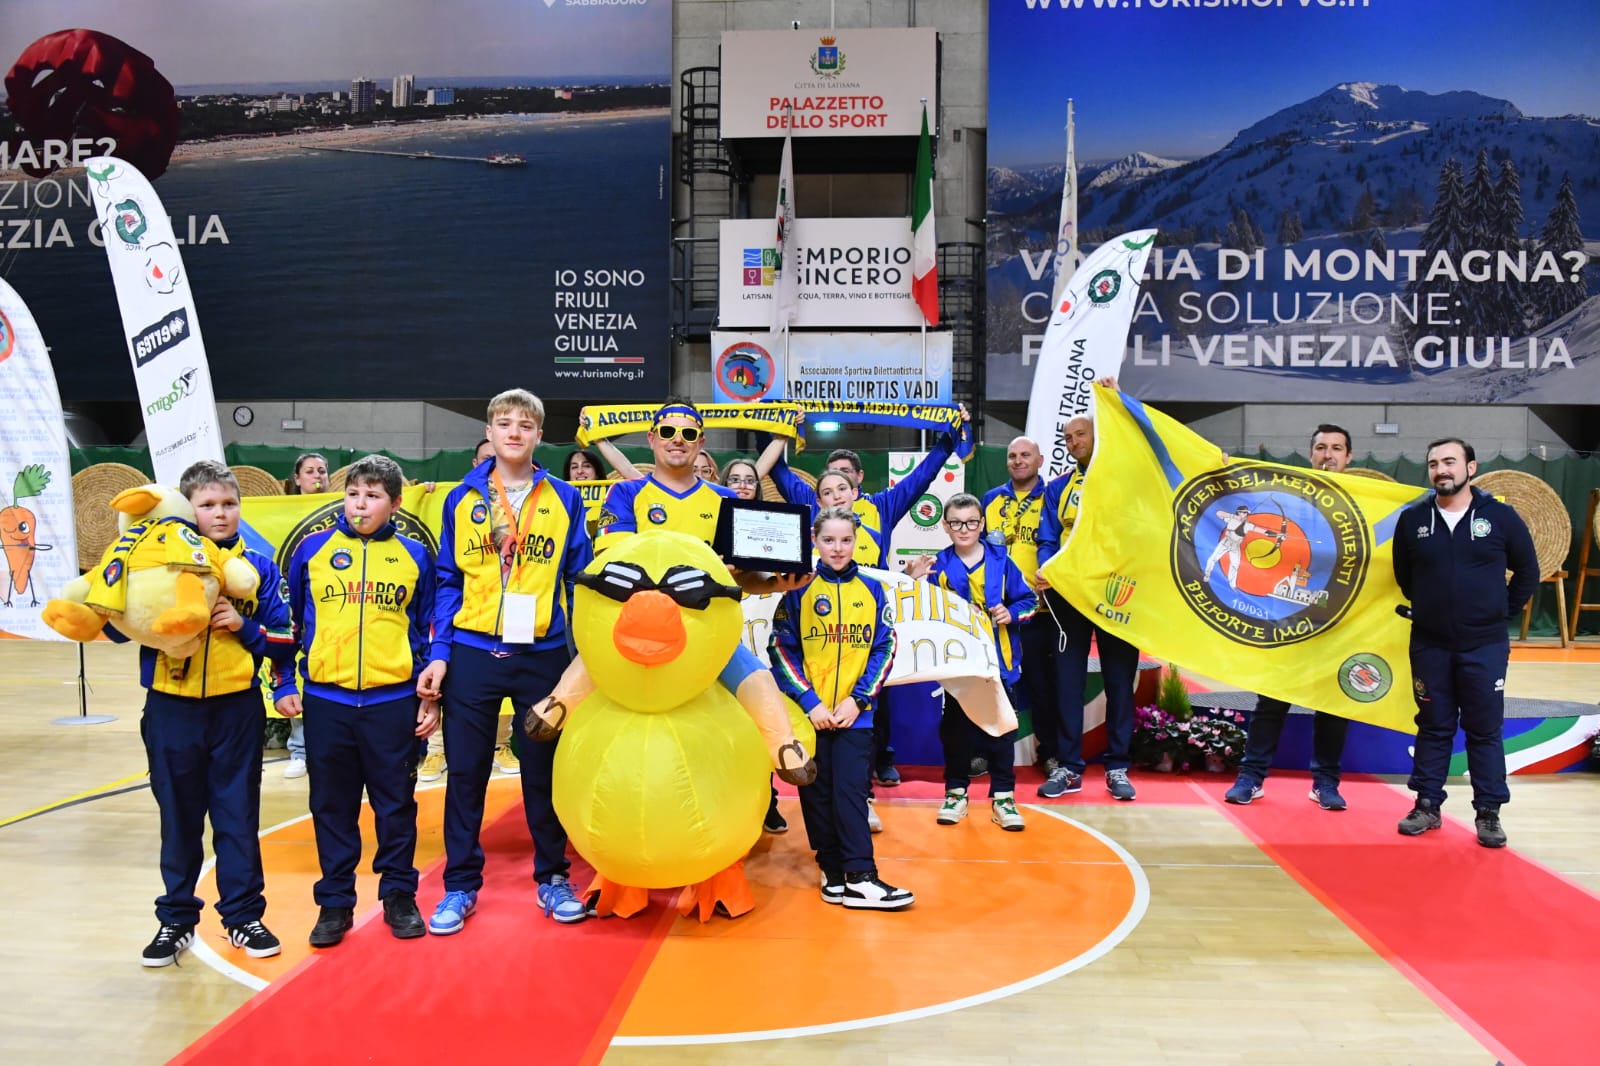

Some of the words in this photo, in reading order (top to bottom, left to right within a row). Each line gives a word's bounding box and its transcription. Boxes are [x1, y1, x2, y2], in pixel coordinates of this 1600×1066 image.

[769, 96, 884, 111] PALAZZETTO
[766, 114, 823, 129] DELLO
[829, 113, 888, 128] SPORT
[0, 137, 117, 170] ARE?
[0, 179, 94, 208] ZION
[0, 218, 74, 249] ZIA
[1217, 249, 1265, 281] DI
[1284, 248, 1587, 283] MONTAGNA?
[555, 270, 577, 287] IO
[583, 269, 645, 287] SONO
[555, 291, 609, 308] FRIULI
[798, 293, 821, 301] CQUA,
[823, 293, 847, 301] TERRA,
[1178, 291, 1462, 325] SOLUZIONE:
[554, 313, 638, 330] VENEZIA
[554, 335, 619, 352] GIULIA
[1187, 334, 1399, 368] VENEZIA
[1413, 335, 1576, 369] GIULIA
[554, 368, 645, 381] www.turismofvg.it
[800, 365, 843, 376] Associazione
[844, 365, 872, 377] Sportiva
[873, 365, 923, 376] Dilettantistica
[1058, 338, 1087, 418] ITALIANA
[787, 380, 841, 399] ARCIERI
[846, 380, 899, 399] CURTIS
[903, 380, 939, 399] VADI
[743, 408, 797, 427] CHIENT
[833, 400, 861, 414] DEL
[863, 402, 909, 418] MEDIO
[1180, 480, 1224, 541] ARCIERI
[1224, 472, 1266, 490] DEL
[1270, 472, 1335, 508] MEDIO
[1332, 510, 1358, 586] CHIENTI
[1185, 578, 1266, 640] BELFORTE
[1273, 616, 1315, 642] (MC)
